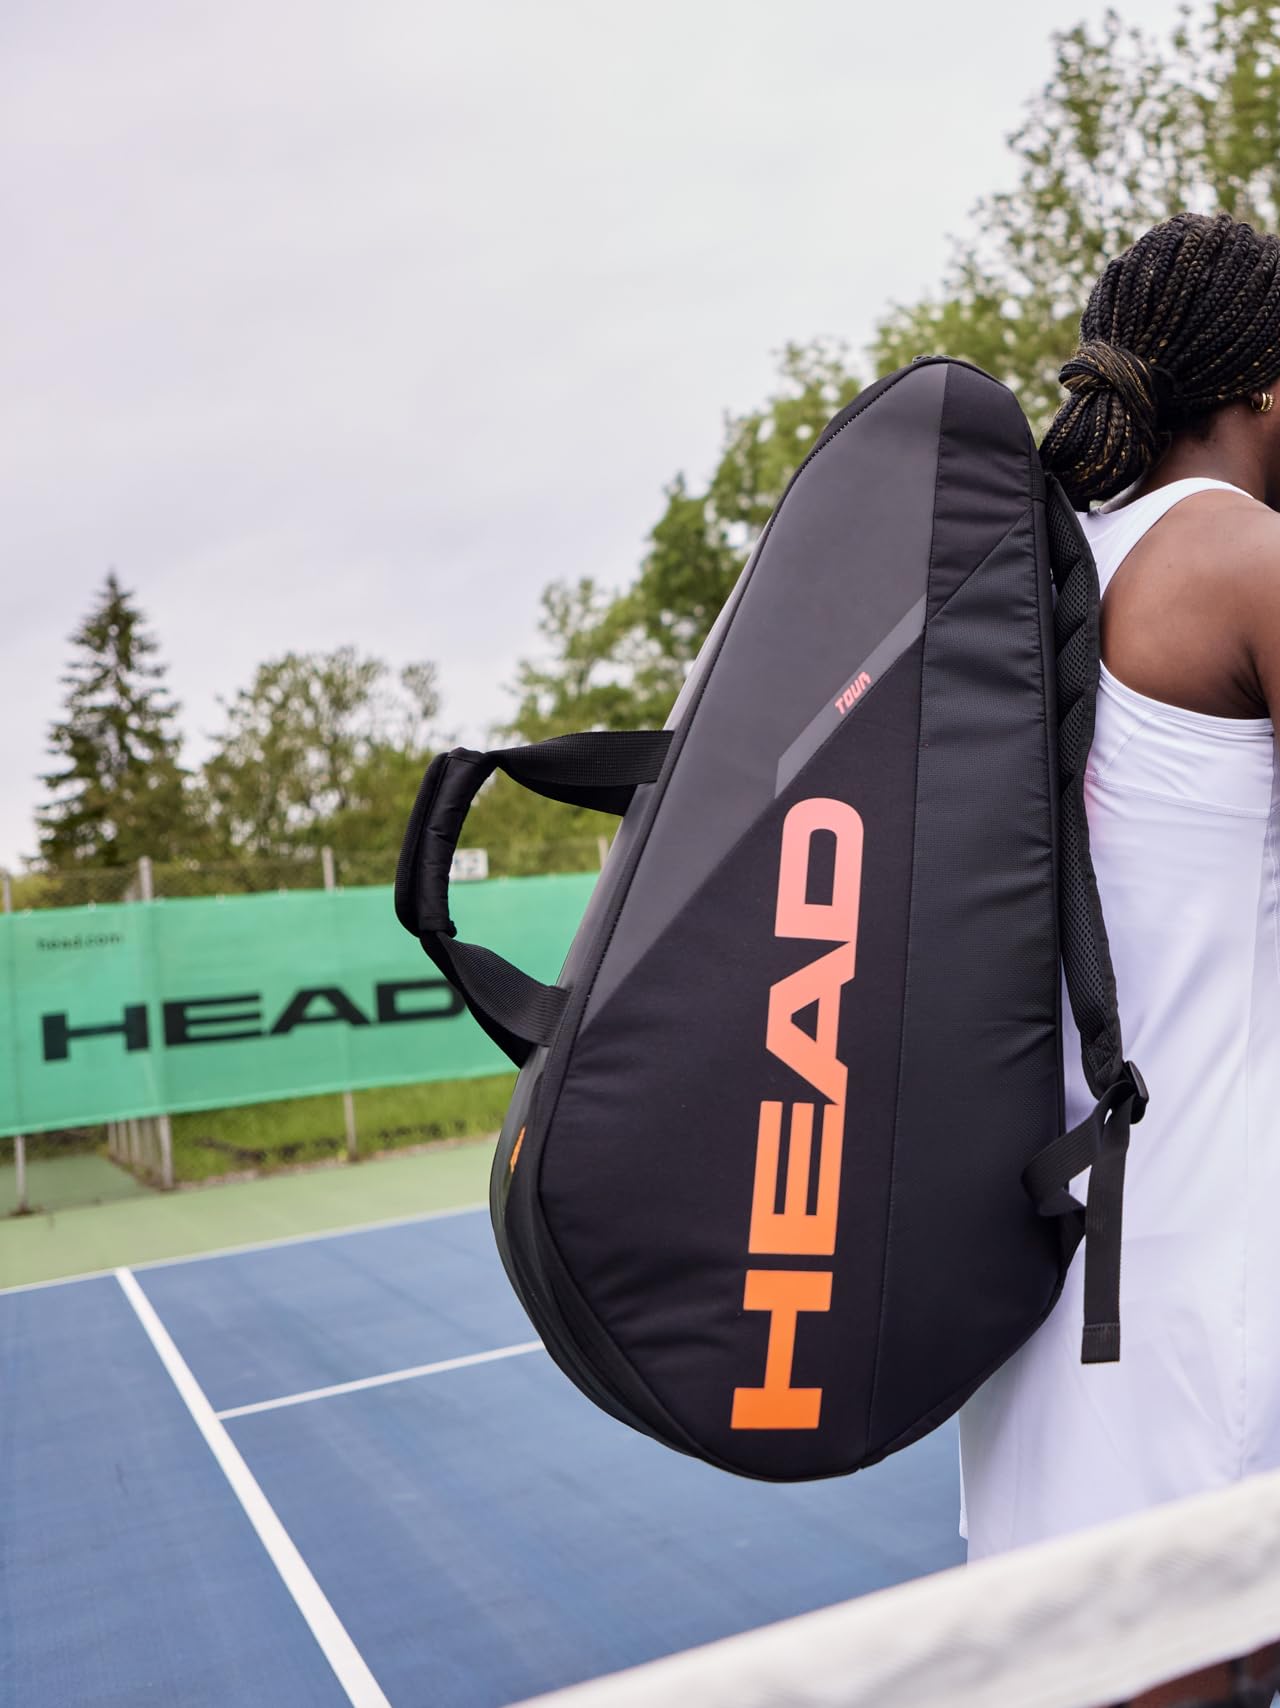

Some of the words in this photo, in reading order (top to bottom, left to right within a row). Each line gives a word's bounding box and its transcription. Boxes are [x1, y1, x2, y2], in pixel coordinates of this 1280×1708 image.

[834, 671, 872, 714] TOUR
[41, 979, 468, 1061] HEAD
[730, 797, 864, 1430] HEAD
